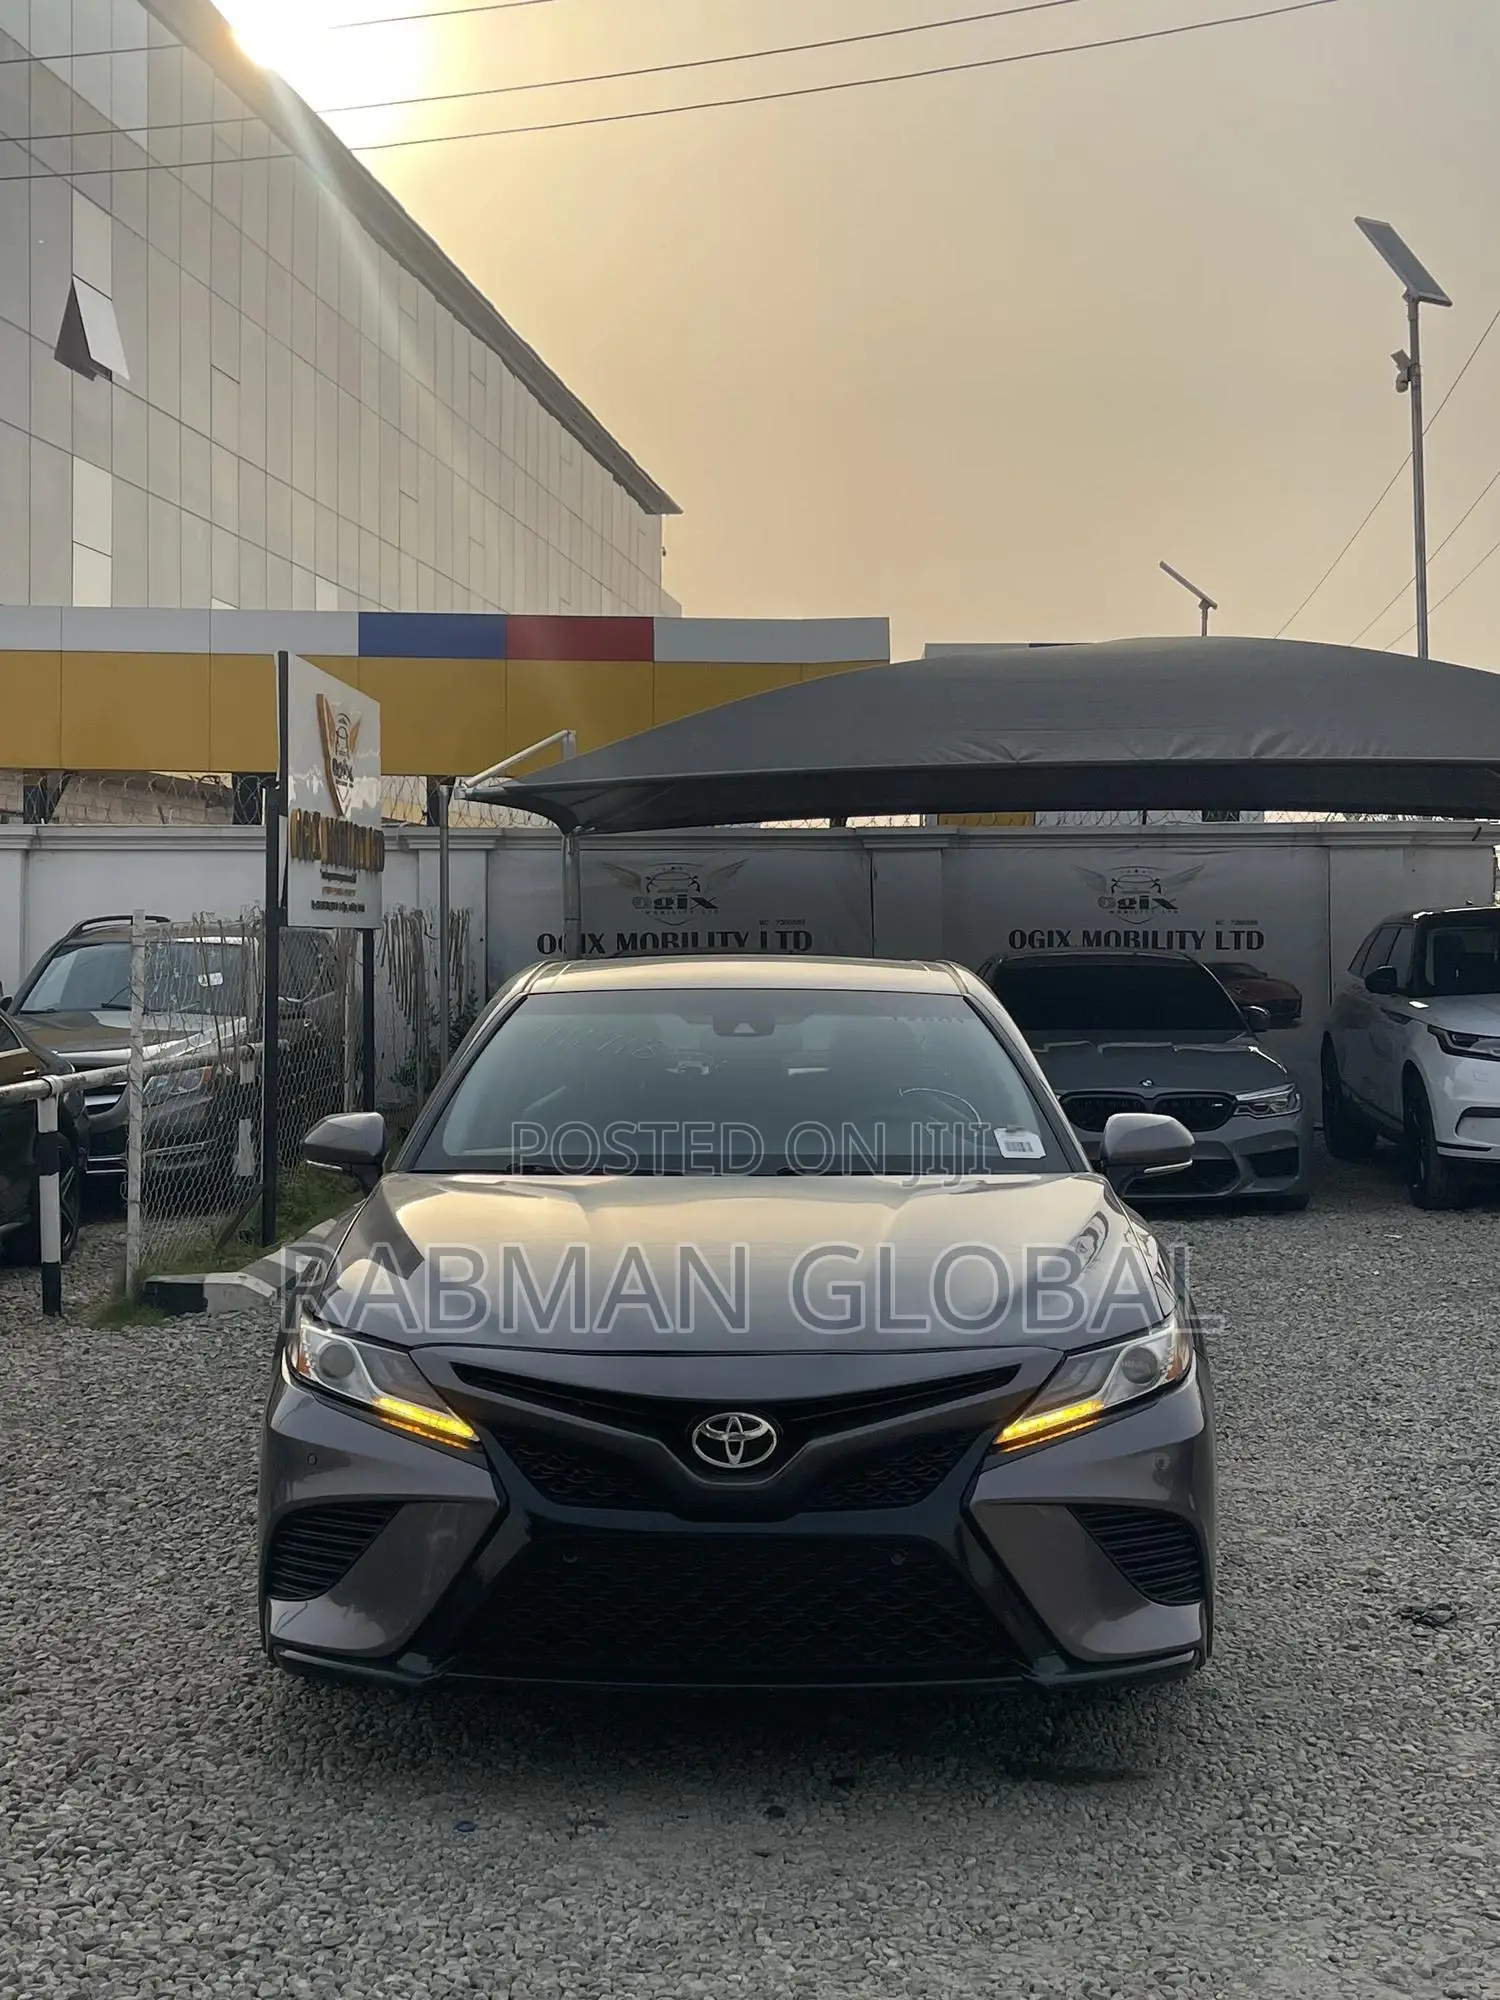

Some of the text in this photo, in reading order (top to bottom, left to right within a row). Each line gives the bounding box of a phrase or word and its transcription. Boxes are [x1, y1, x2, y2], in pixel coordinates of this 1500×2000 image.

[616, 931, 749, 951] MOBILITY
[1008, 929, 1265, 950] OGIX MOBILITY LTD
